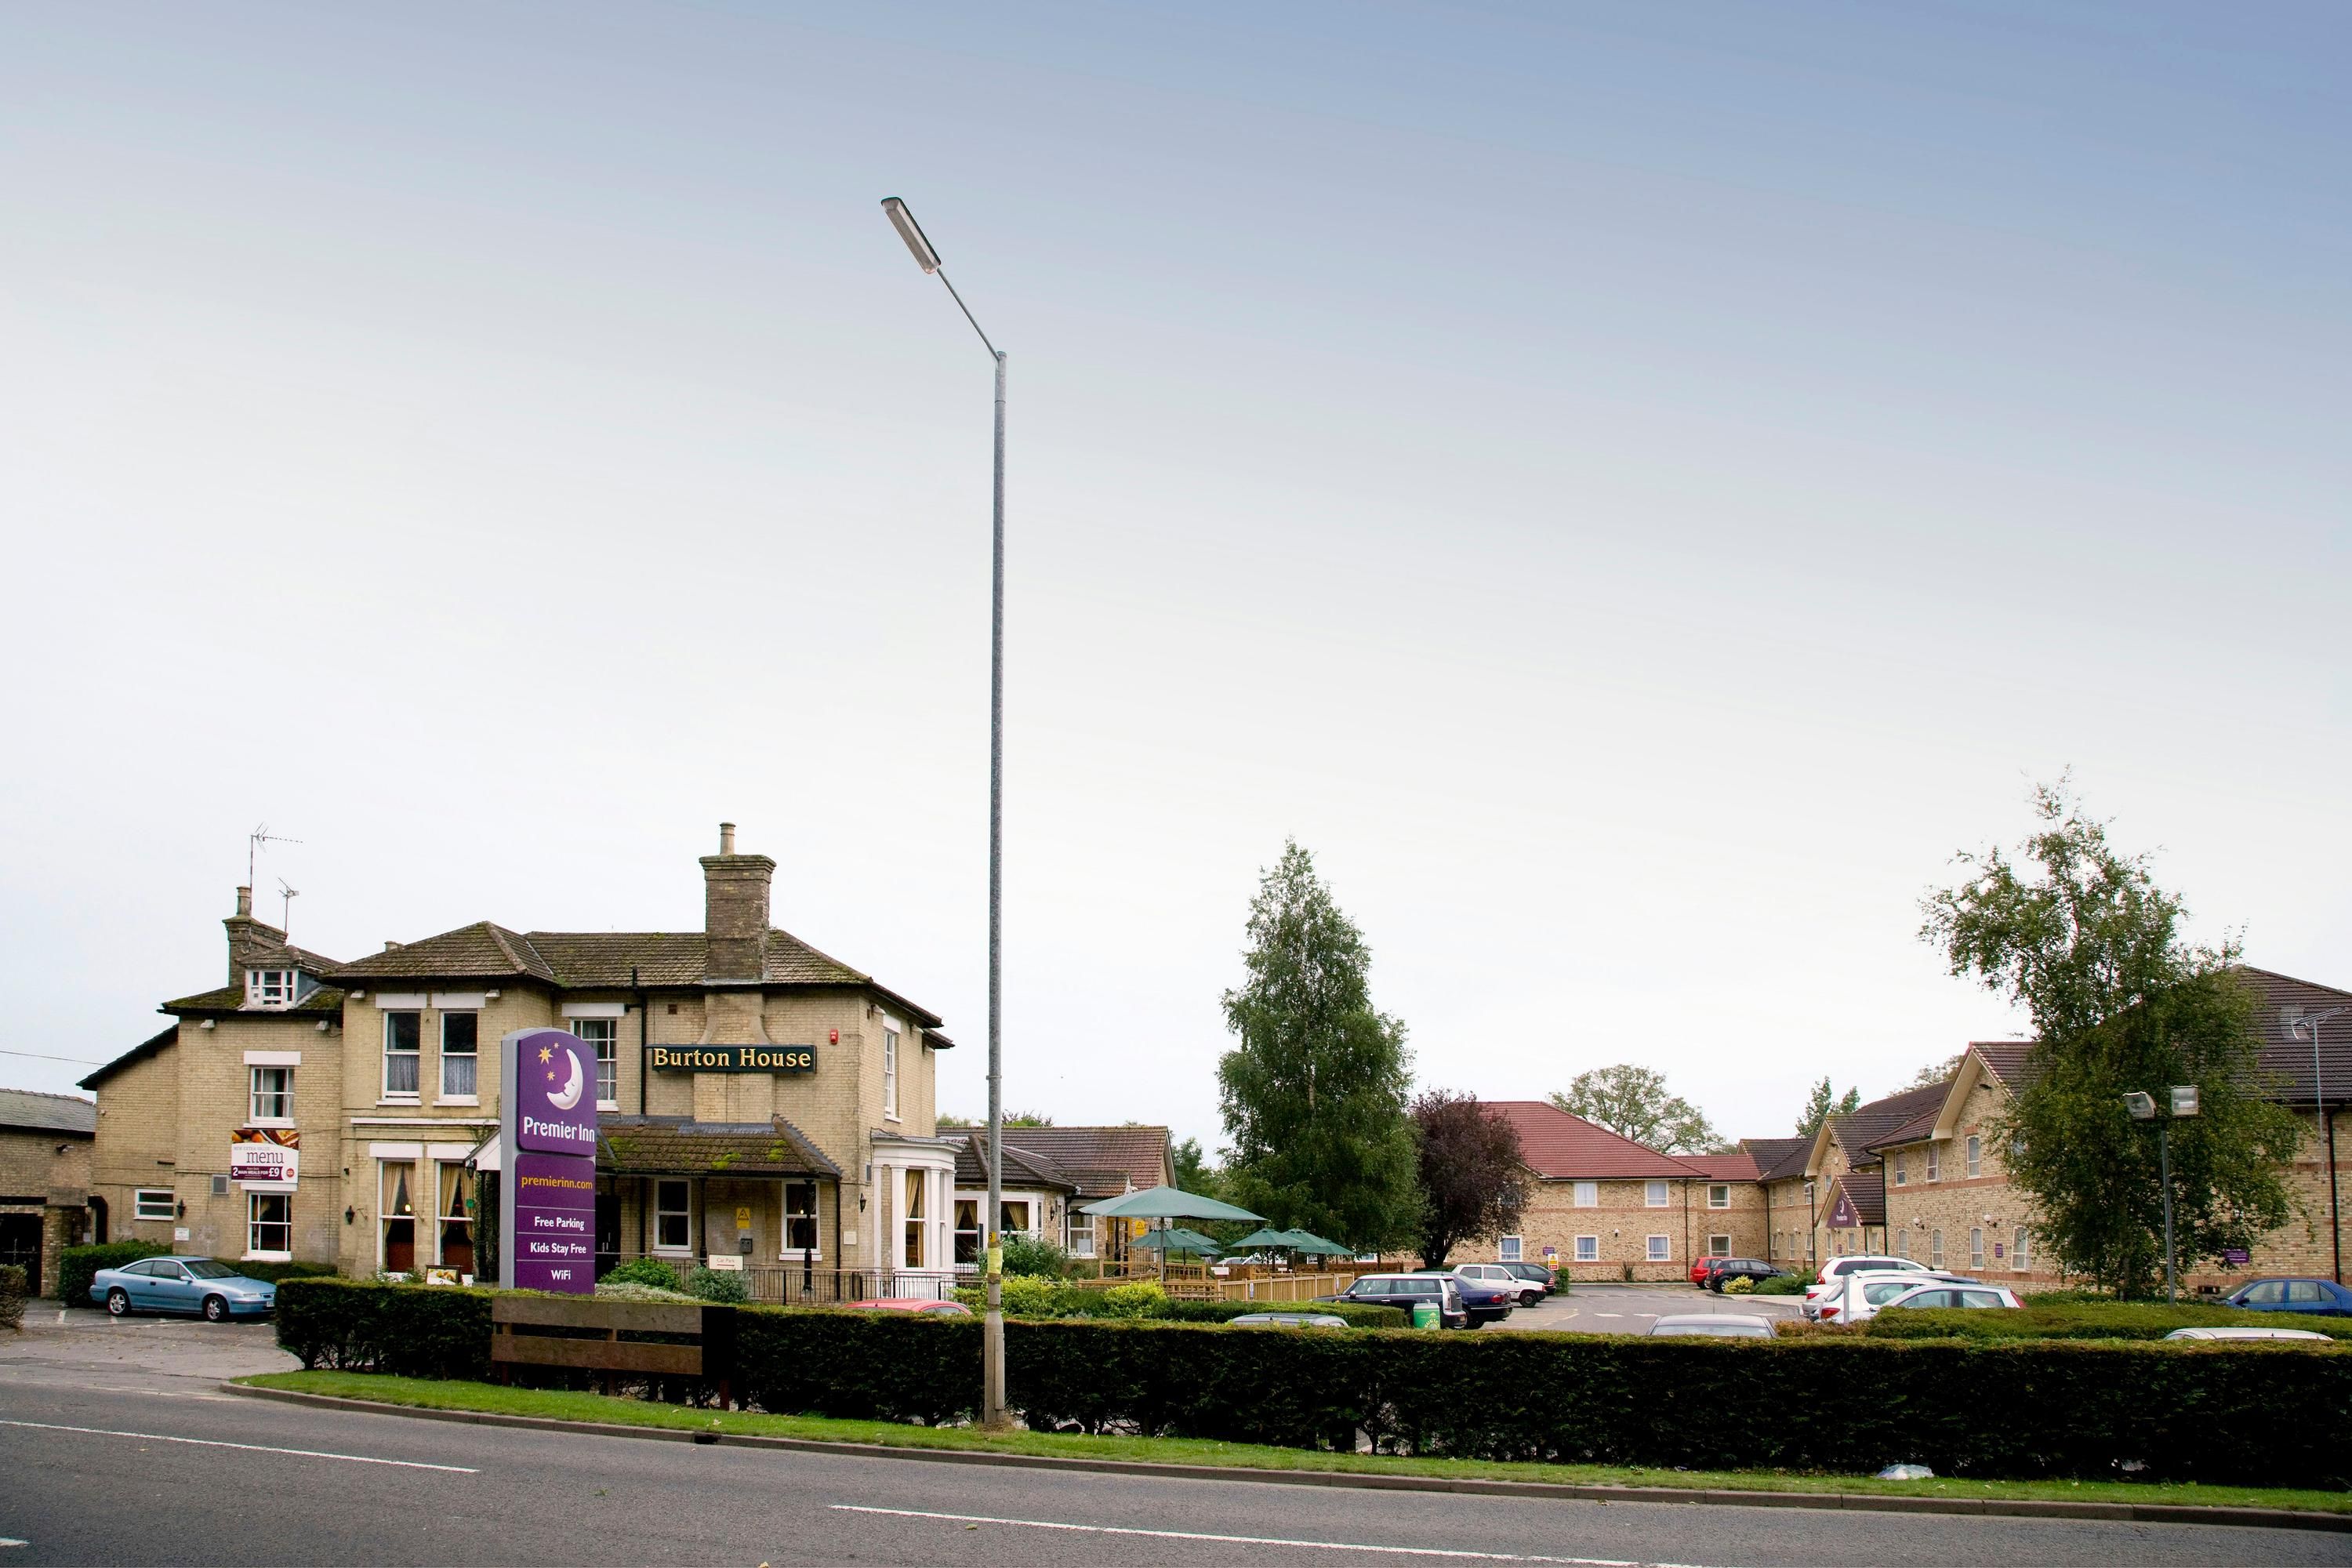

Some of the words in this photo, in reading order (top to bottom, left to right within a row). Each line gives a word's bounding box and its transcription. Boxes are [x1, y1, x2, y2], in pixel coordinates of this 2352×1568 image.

[653, 1047, 730, 1067] Burton
[739, 1048, 811, 1067] House
[524, 1116, 577, 1140] Premier
[579, 1123, 595, 1142] Inn
[246, 1152, 284, 1163] menu
[233, 1167, 238, 1176] 2
[269, 1167, 280, 1177] £9
[521, 1176, 593, 1189] premierinn.com
[534, 1216, 554, 1227] Free
[556, 1217, 585, 1231] Parking
[530, 1242, 550, 1253] Kids
[551, 1243, 568, 1256] Stay
[570, 1243, 586, 1254] Free
[551, 1270, 571, 1280] WiFi
